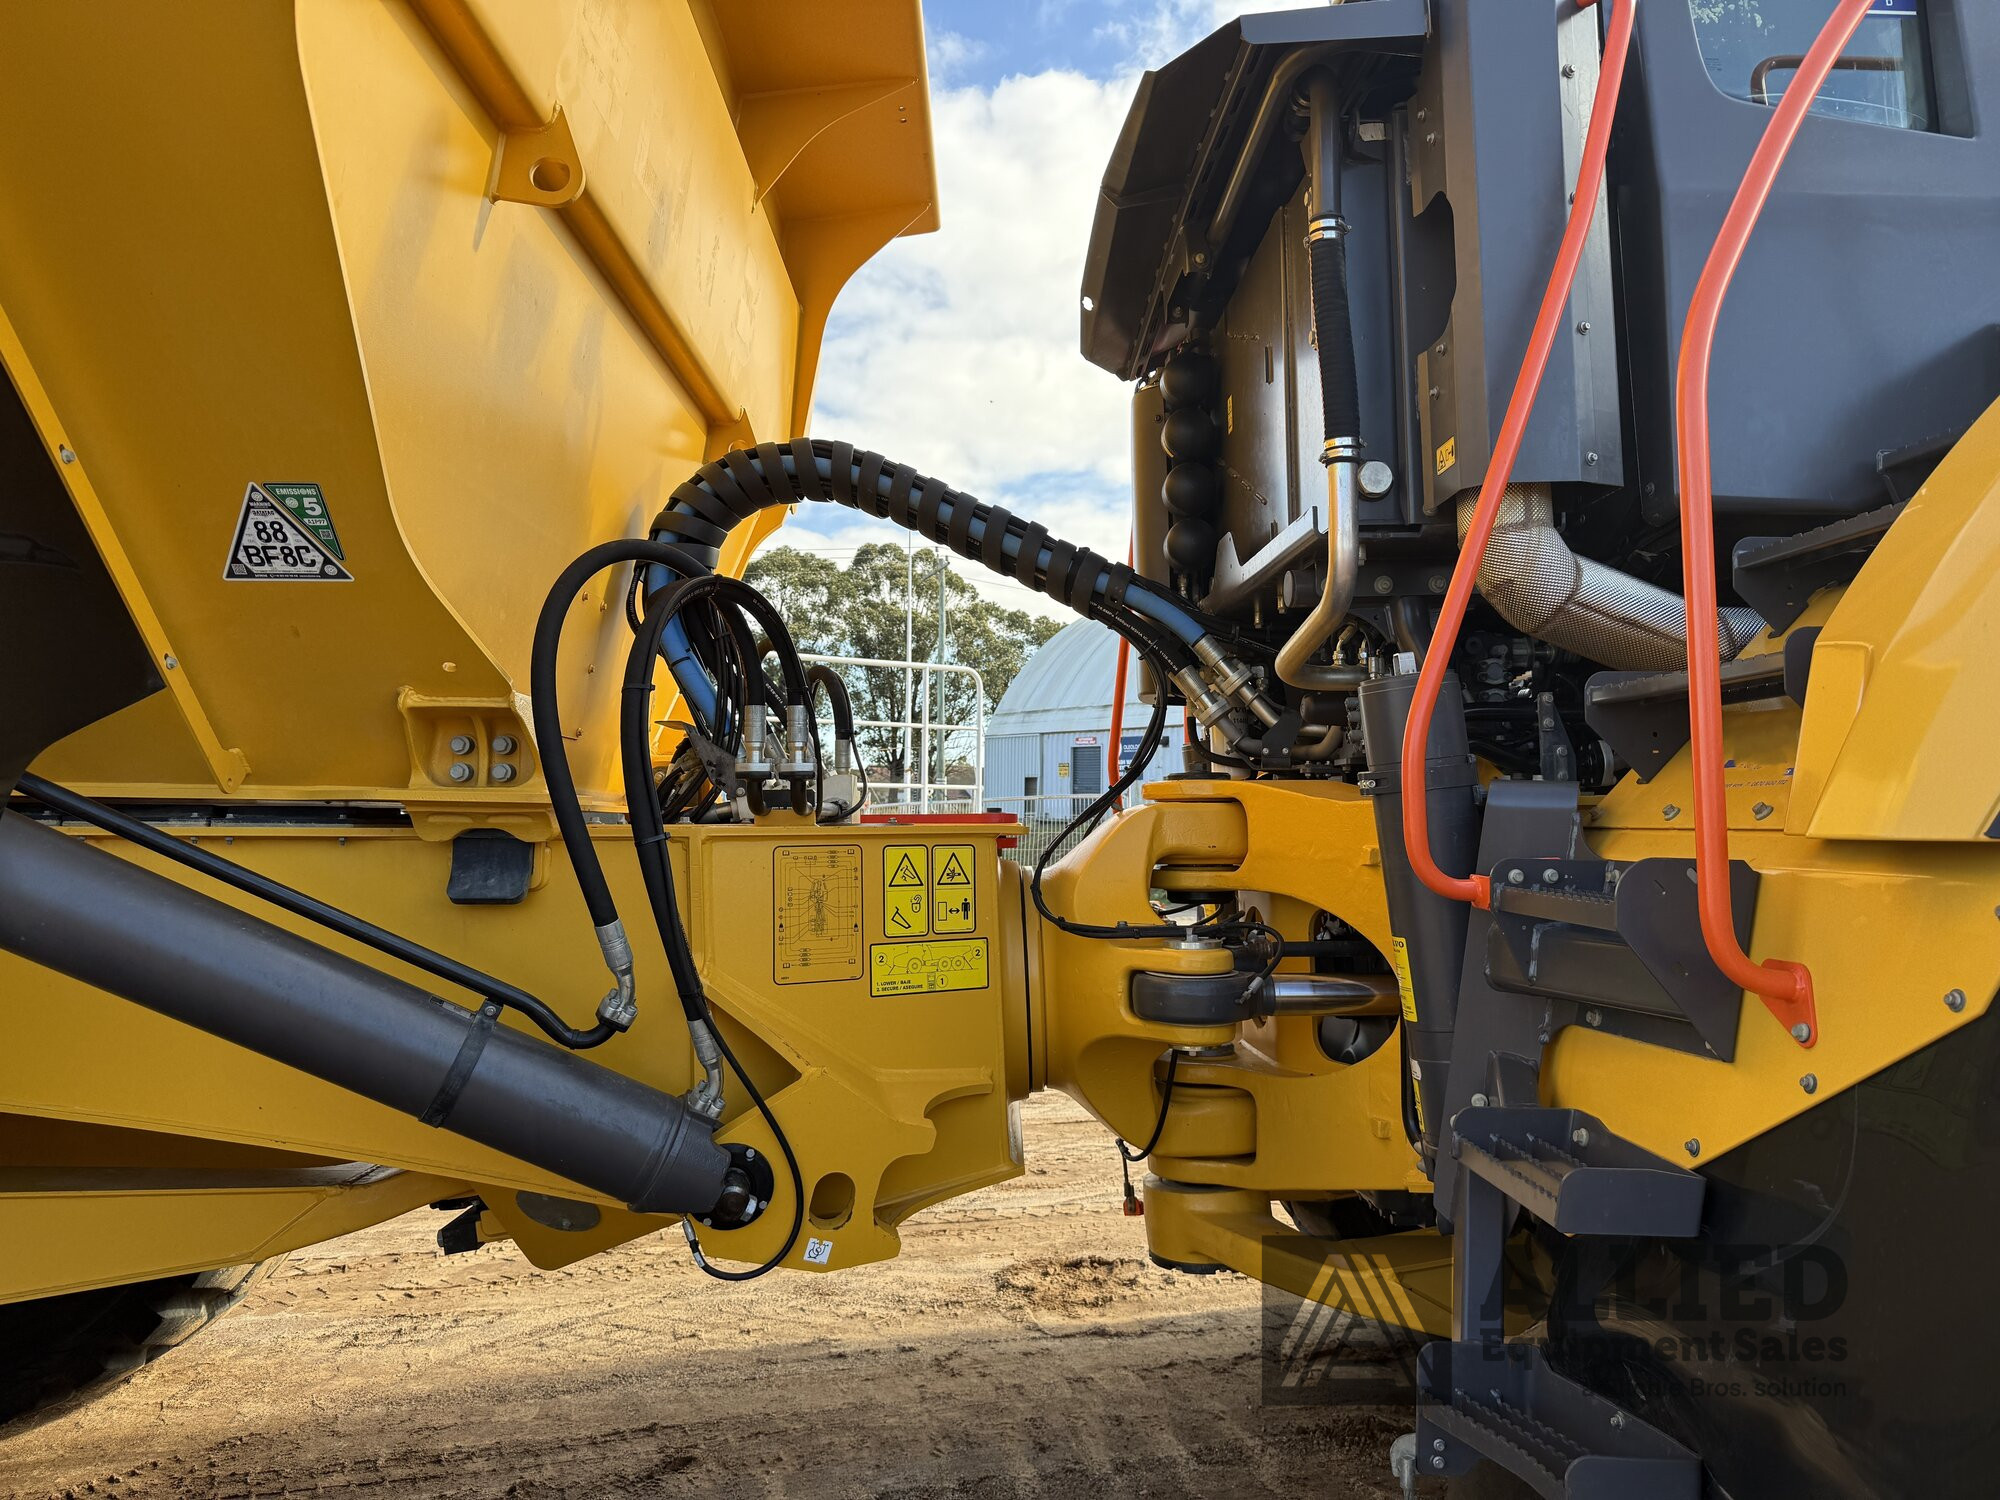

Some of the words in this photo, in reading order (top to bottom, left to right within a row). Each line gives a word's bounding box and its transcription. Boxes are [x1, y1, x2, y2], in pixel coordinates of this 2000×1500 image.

[303, 498, 322, 516] 5
[253, 521, 288, 543] 88
[243, 545, 316, 568] BF8C
[878, 955, 884, 963] 2
[975, 949, 981, 957] 2
